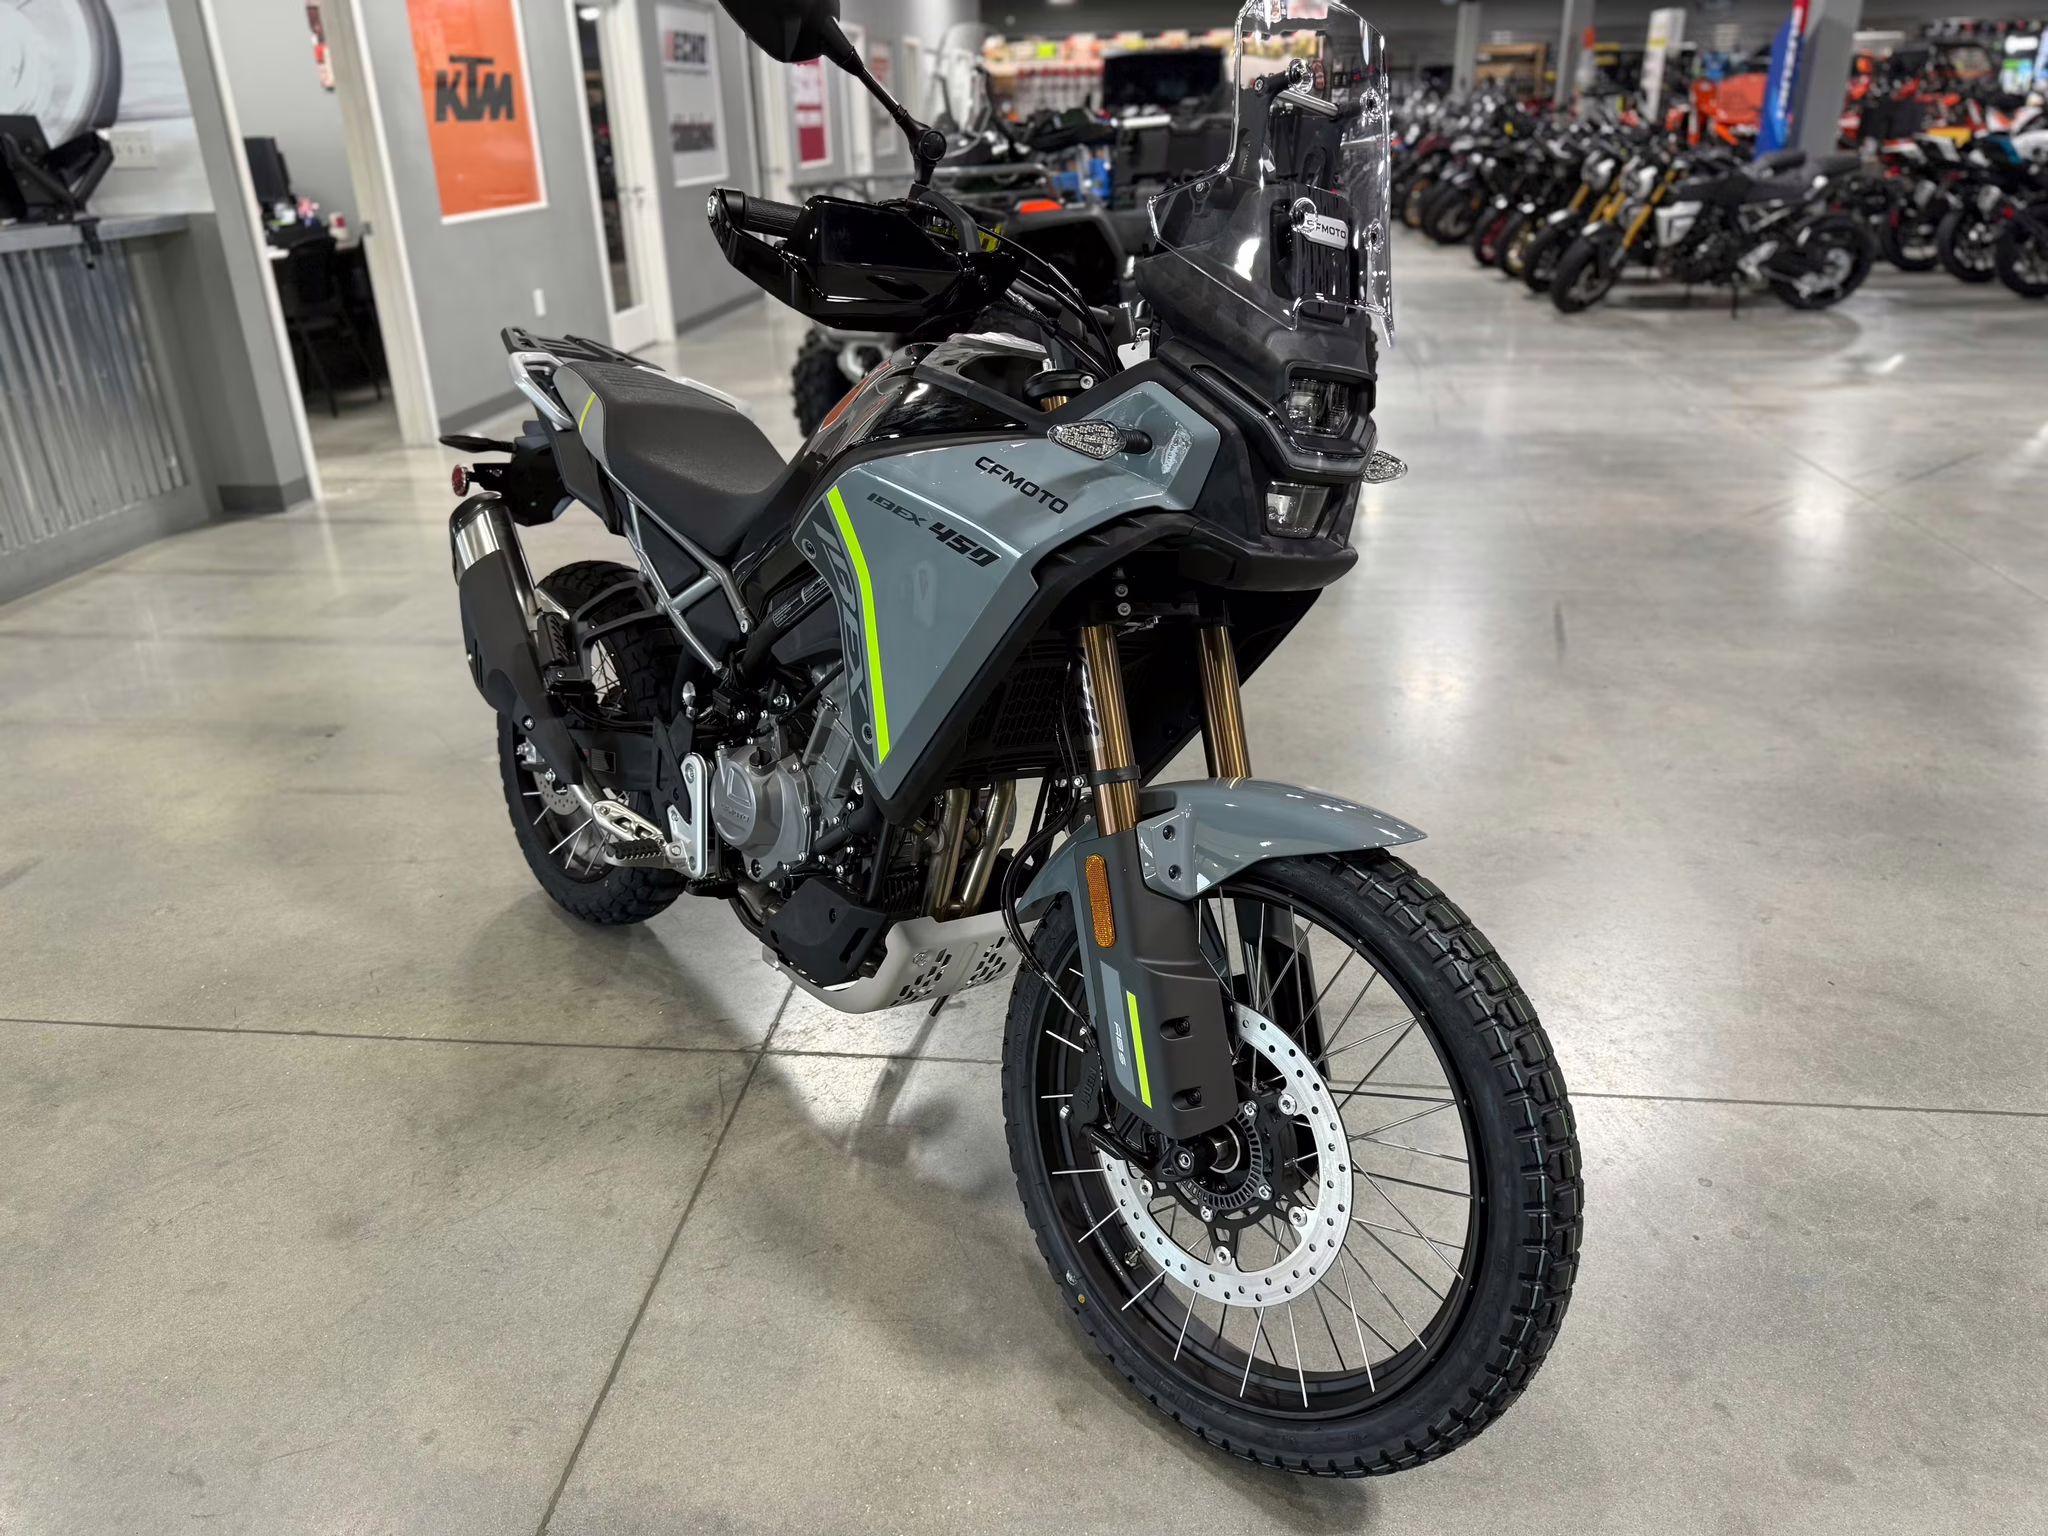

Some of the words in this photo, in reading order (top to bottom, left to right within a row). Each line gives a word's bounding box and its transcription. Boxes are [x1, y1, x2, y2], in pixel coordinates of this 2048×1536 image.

[436, 55, 514, 122] KTM
[975, 456, 1069, 515] CFMOTO
[866, 492, 928, 528] IBEX
[928, 521, 1002, 568] 450
[812, 520, 869, 716] IBEX
[1113, 1021, 1127, 1066] ABS
